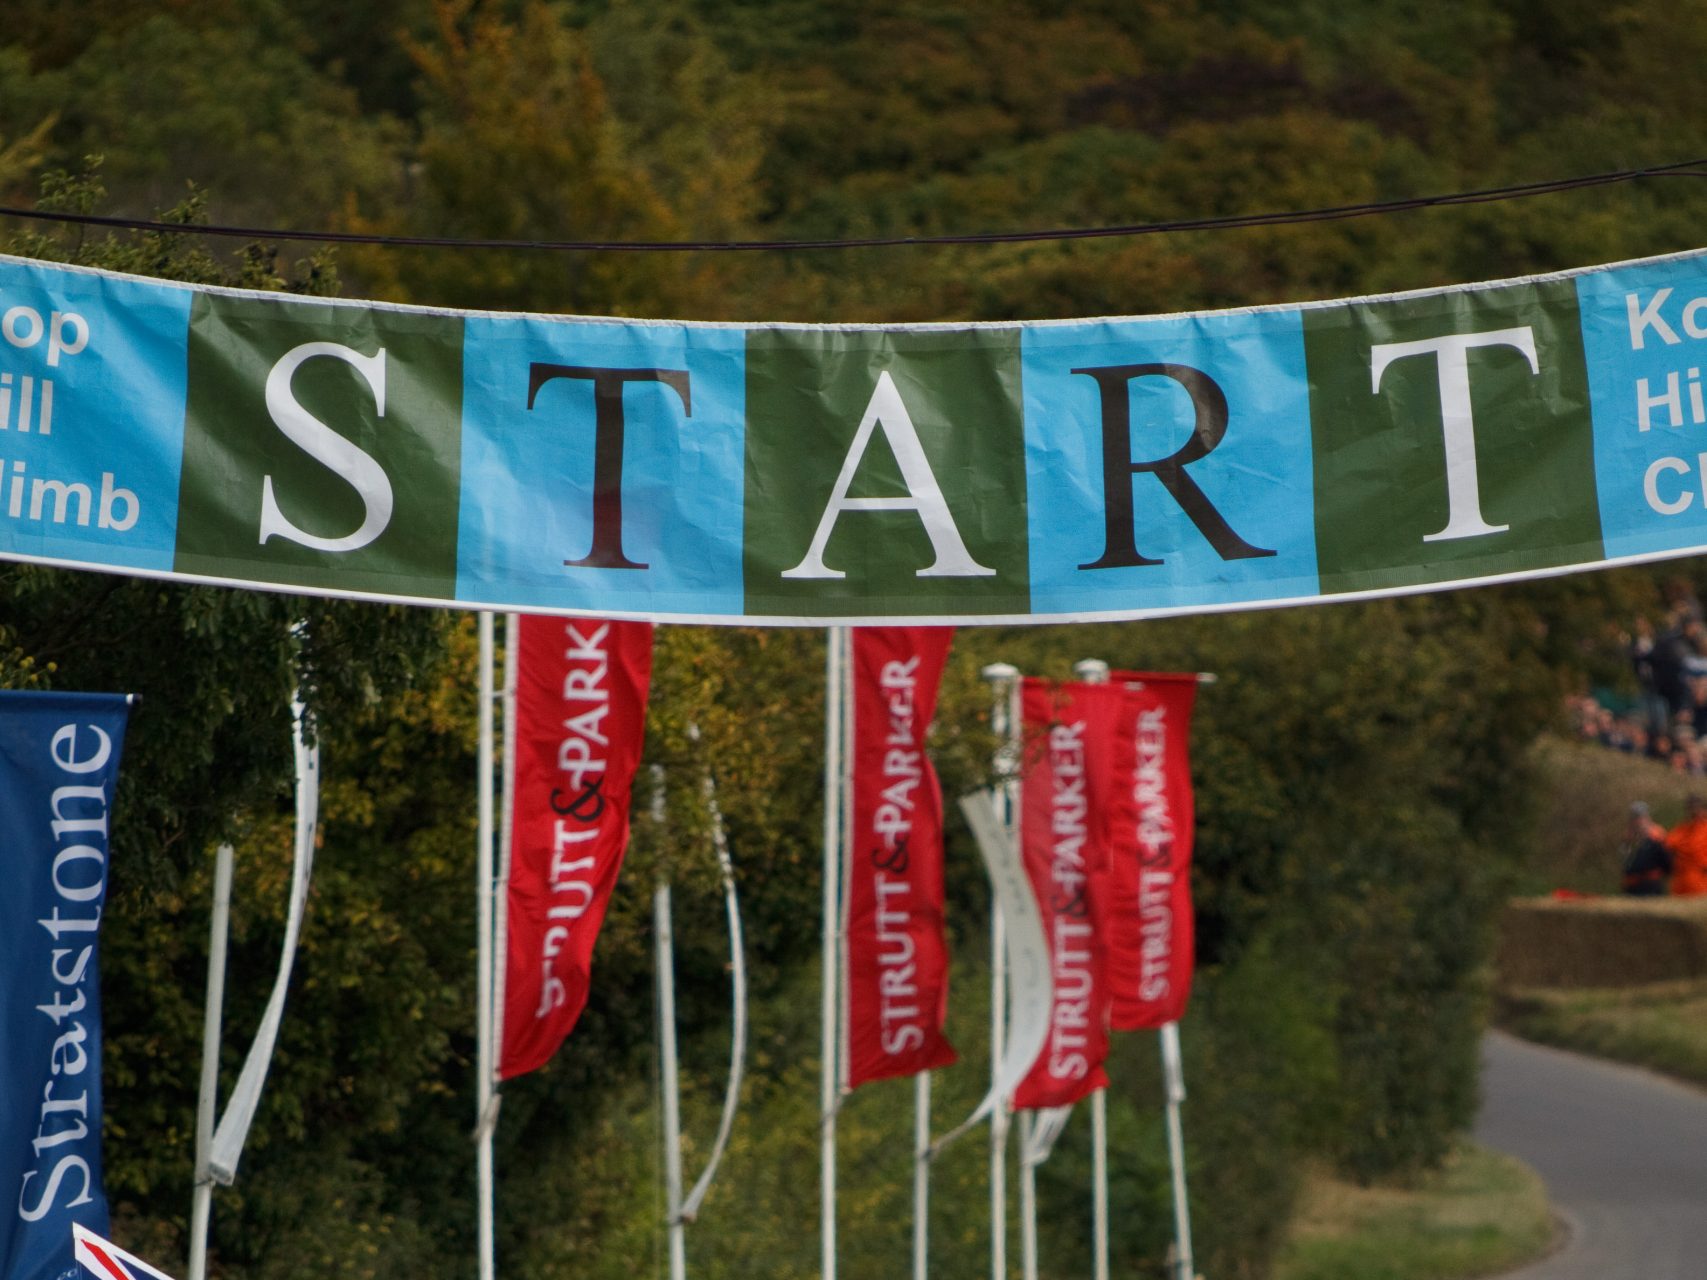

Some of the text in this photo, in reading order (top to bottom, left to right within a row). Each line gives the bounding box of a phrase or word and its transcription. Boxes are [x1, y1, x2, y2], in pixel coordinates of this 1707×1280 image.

[0, 372, 53, 435] ill
[2, 306, 89, 367] op
[1636, 367, 1706, 432] Hi
[0, 459, 140, 531] imb
[259, 325, 1540, 579] START
[1133, 706, 1175, 857] PARKER
[871, 656, 924, 1056] STRUTT & PARKER
[1049, 720, 1092, 1080] STRUTT & PARKER
[18, 723, 112, 1224] Stratstone
[1138, 868, 1175, 1003] STRUTT
